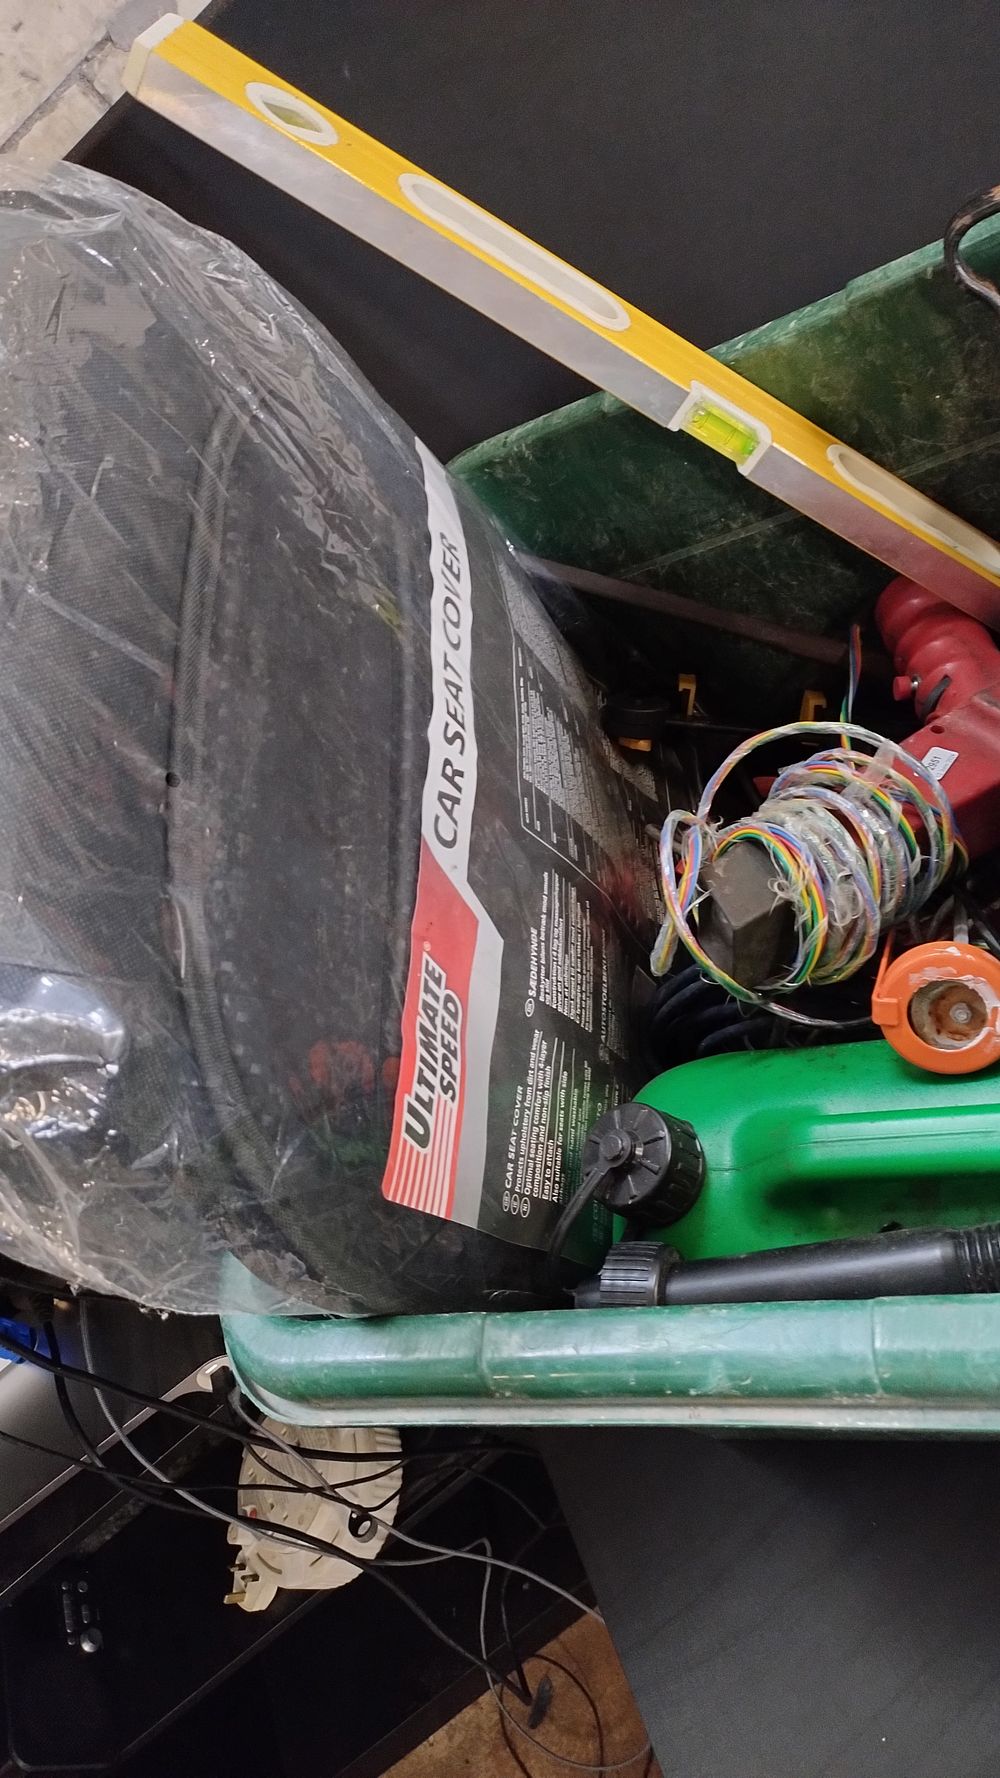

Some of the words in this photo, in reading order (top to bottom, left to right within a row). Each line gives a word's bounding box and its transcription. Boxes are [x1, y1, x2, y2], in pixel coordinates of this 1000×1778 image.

[440, 531, 463, 652] COVER
[443, 662, 466, 756] SEAT
[433, 763, 464, 849] CAR
[528, 927, 538, 997] SÆDEHYNDE
[404, 959, 443, 1149] ULTIMATE
[439, 990, 460, 1103] SPEED
[531, 1029, 540, 1050] wear
[539, 1040, 548, 1069] 4-layer
[536, 1071, 544, 1089] with
[543, 1066, 551, 1088] finish
[560, 1071, 568, 1088] side
[513, 1085, 523, 1126] COVER
[523, 1086, 533, 1108] from
[532, 1091, 543, 1125] comfort
[540, 1090, 552, 1124] non-slip
[508, 1129, 518, 1159] SEAT
[518, 1109, 530, 1155] upholstery
[528, 1126, 540, 1158] seating
[538, 1125, 546, 1142] and
[545, 1139, 554, 1167] attach
[553, 1148, 563, 1181] suitable
[505, 1162, 515, 1188] CAR
[515, 1157, 524, 1193] Protects
[524, 1159, 536, 1195] Optimal
[532, 1144, 545, 1197] composition
[544, 1168, 552, 1178] to
[542, 1179, 552, 1200] Easy
[552, 1184, 560, 1203] Also
